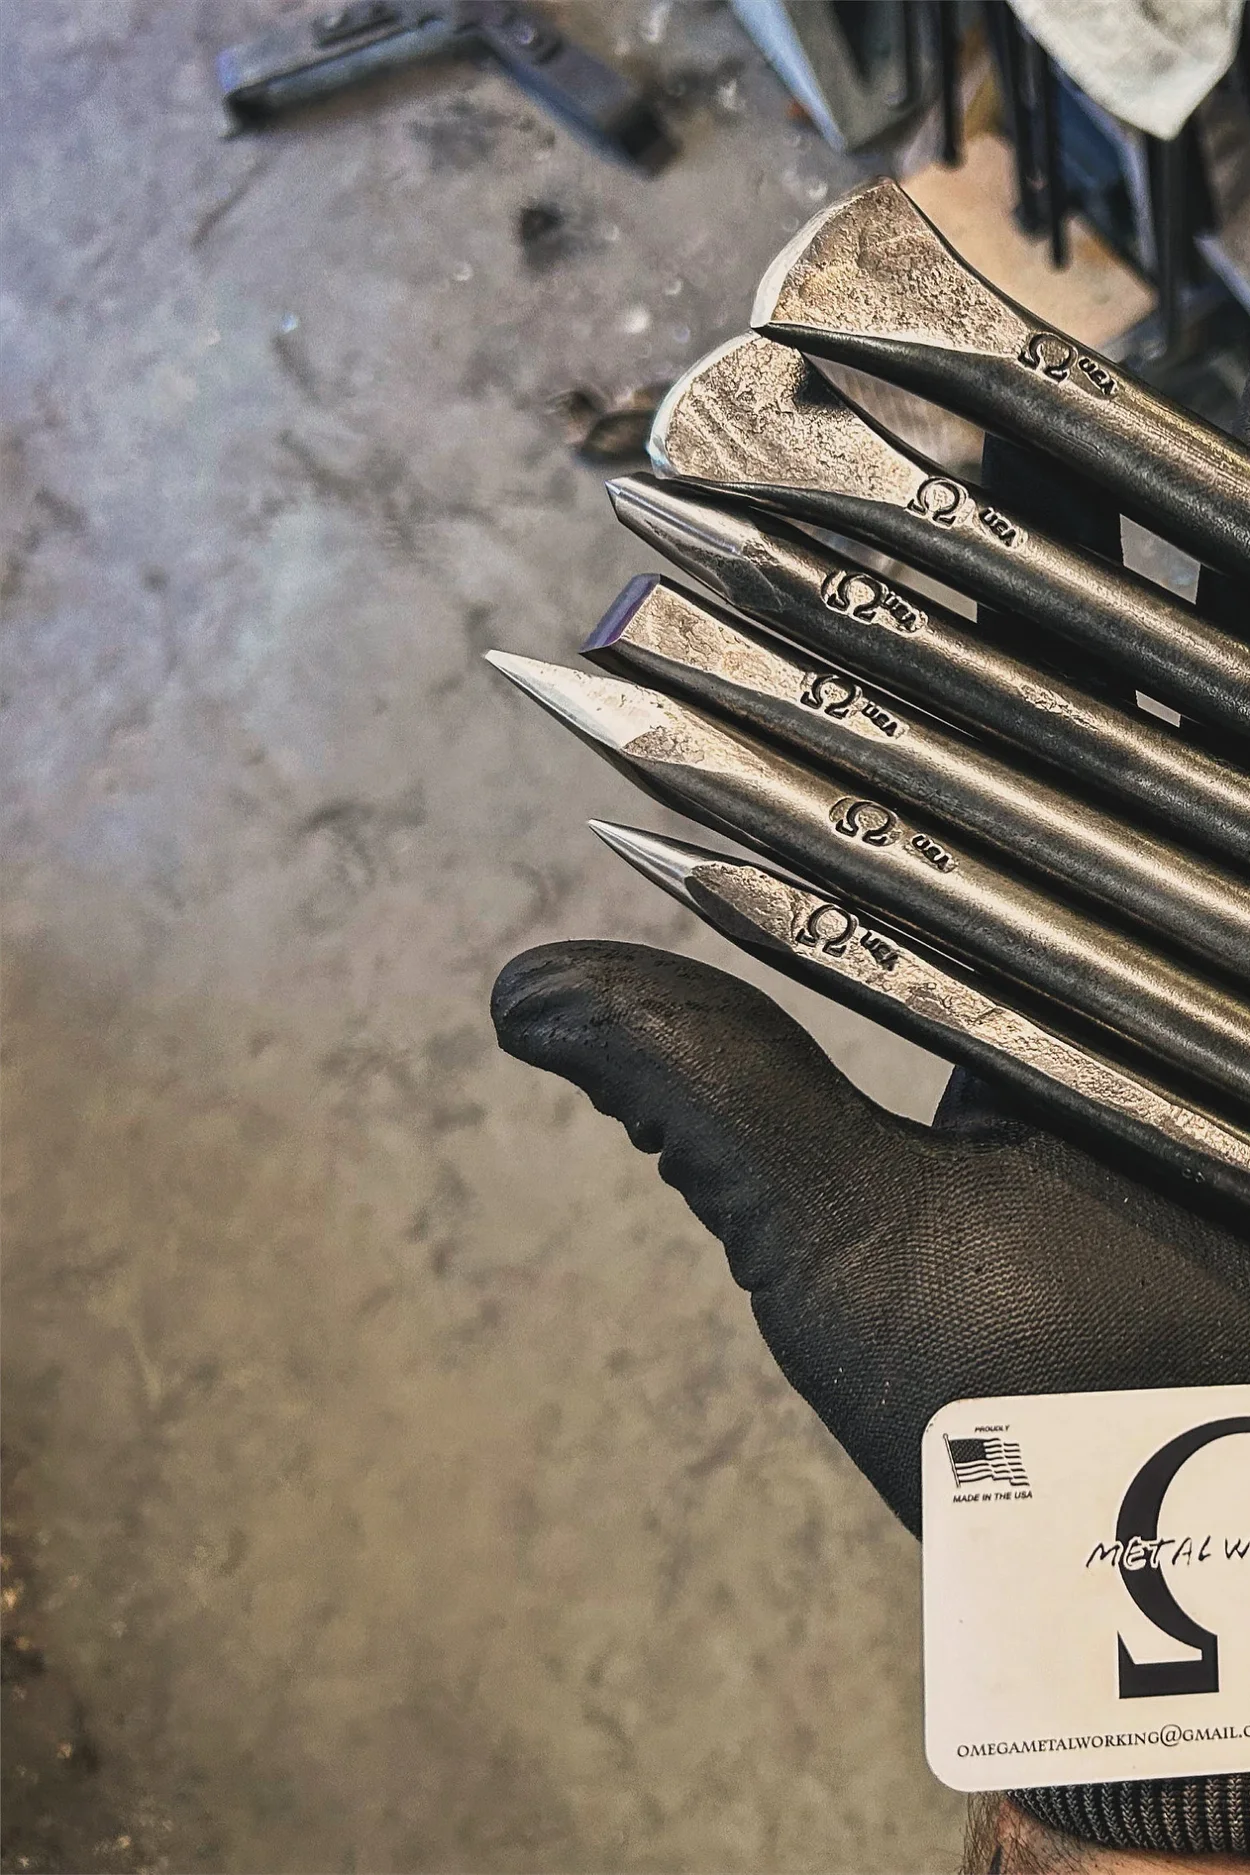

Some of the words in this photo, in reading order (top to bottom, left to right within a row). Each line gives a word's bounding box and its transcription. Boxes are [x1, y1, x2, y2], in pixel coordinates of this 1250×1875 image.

[974, 1424, 1010, 1433] PROUDLY
[953, 1493, 980, 1503] MADE
[982, 1492, 992, 1501] IN
[994, 1491, 1012, 1501] THE
[1014, 1490, 1033, 1500] USA
